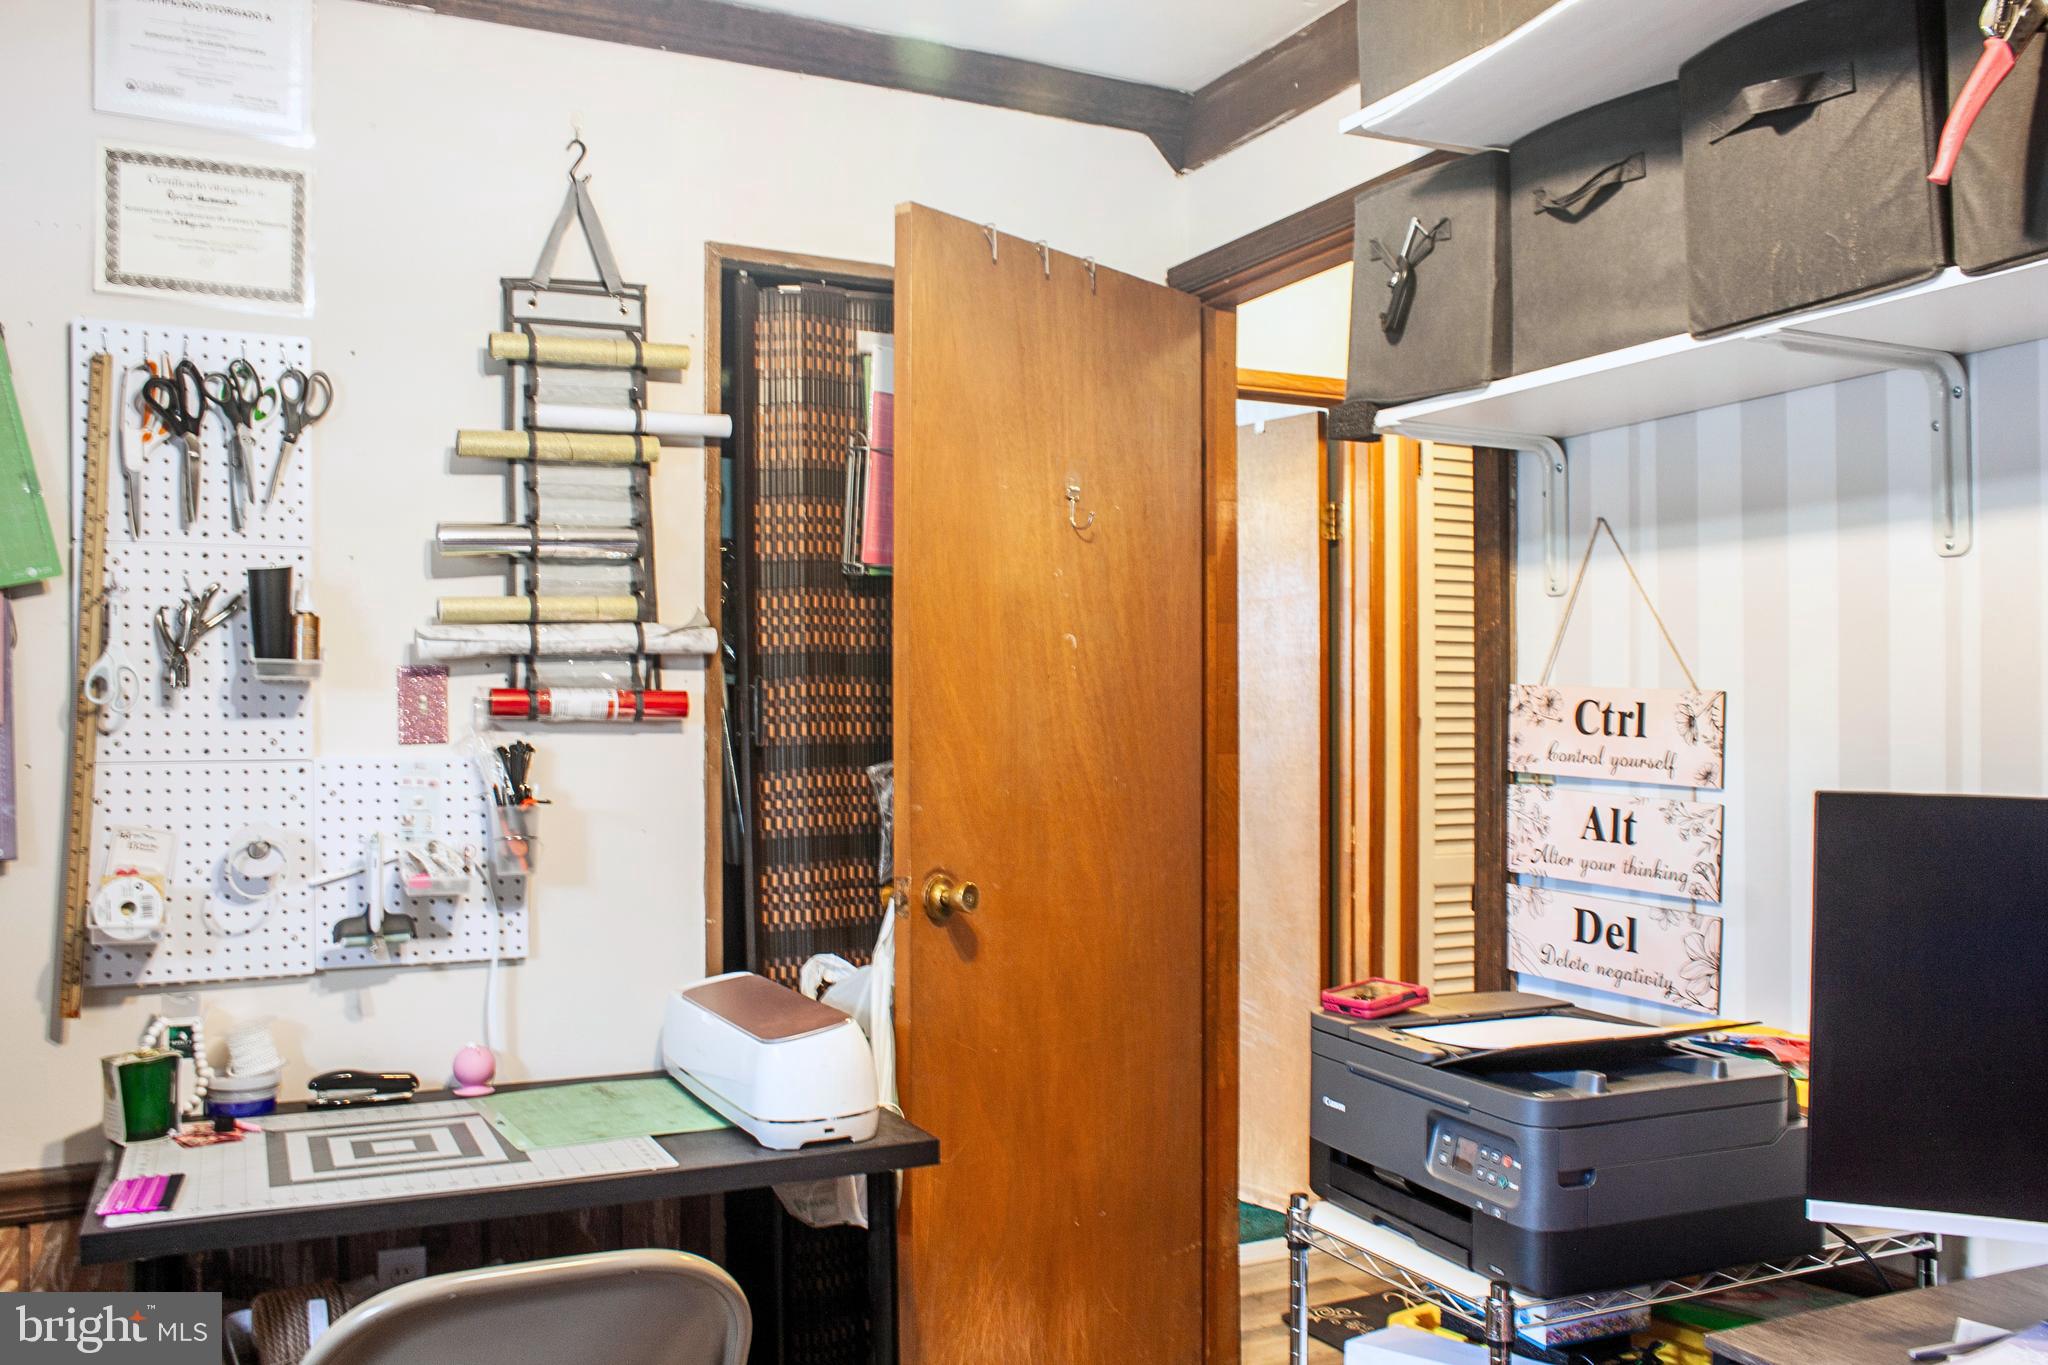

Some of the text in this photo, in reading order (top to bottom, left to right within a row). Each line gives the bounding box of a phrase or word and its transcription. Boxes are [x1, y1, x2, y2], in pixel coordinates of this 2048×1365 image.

[1574, 699, 1648, 738] Ctrl
[1547, 740, 1677, 779] Control yourself
[1579, 805, 1638, 846] Alt
[1531, 848, 1689, 892] Alter your thinking
[1573, 907, 1639, 954] Del
[1540, 942, 1674, 998] Delete negativity
